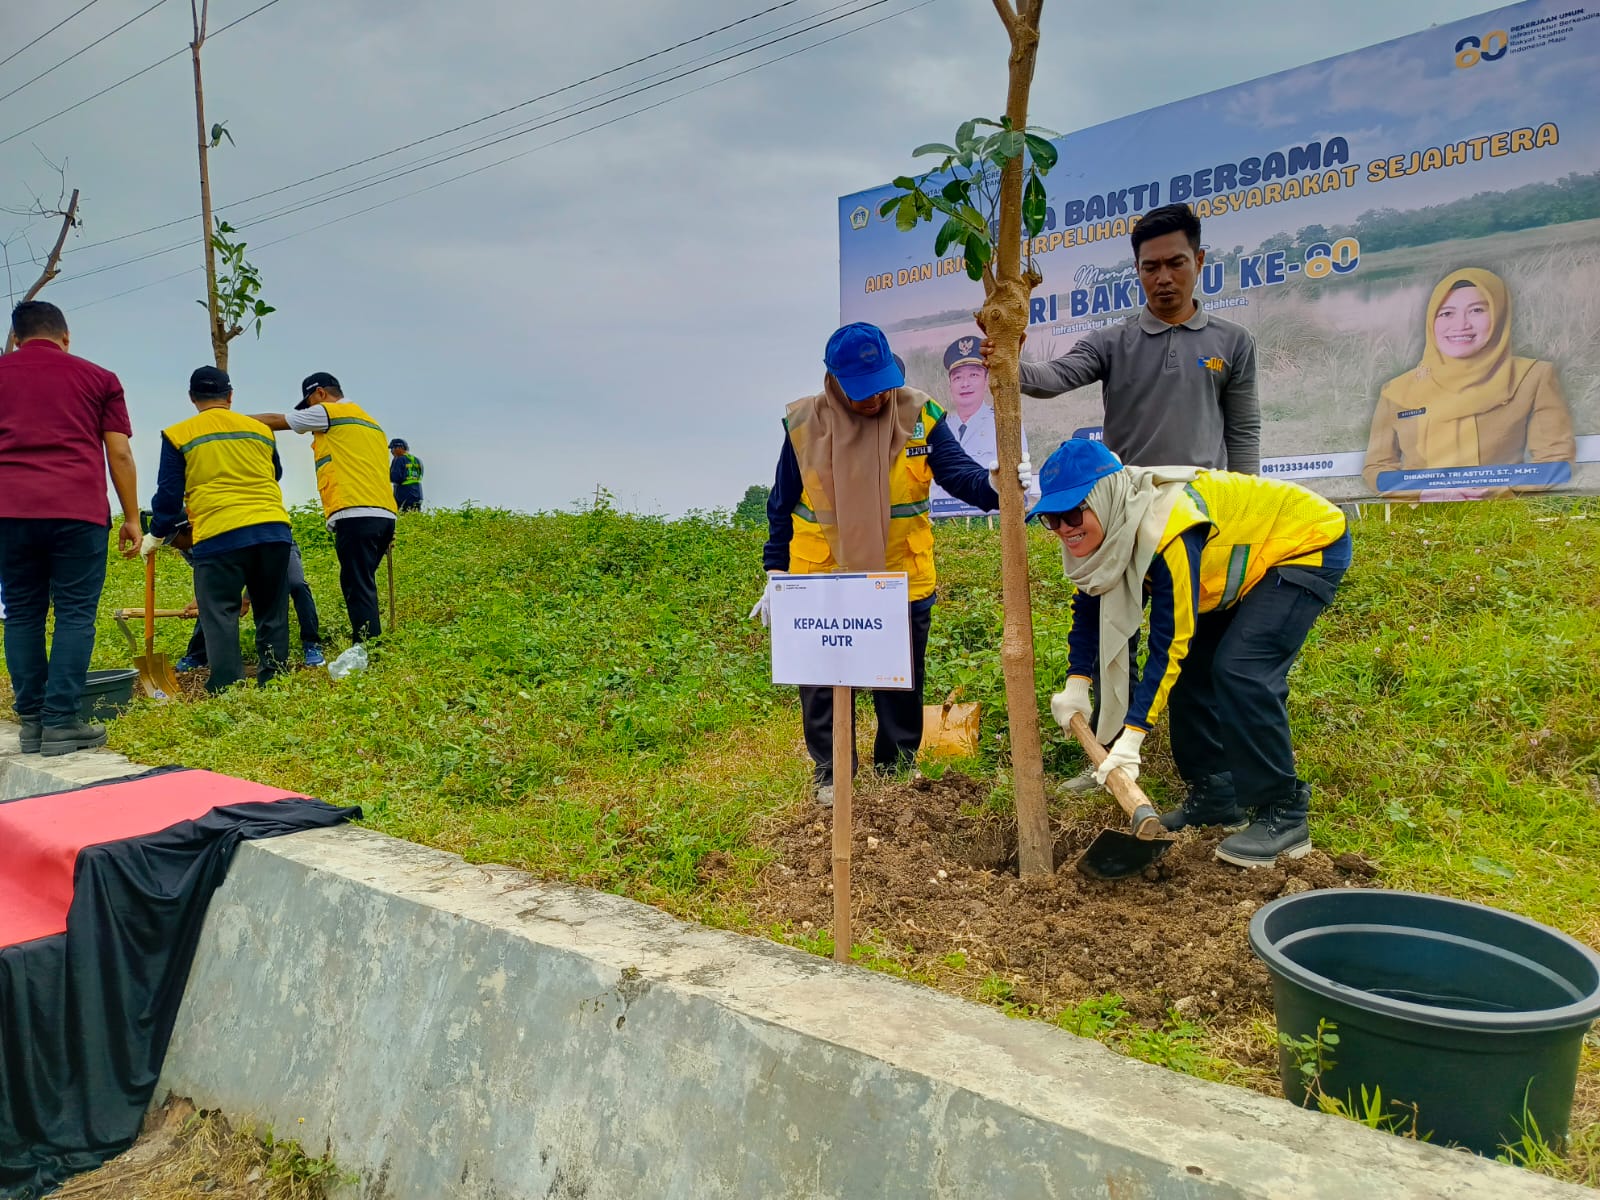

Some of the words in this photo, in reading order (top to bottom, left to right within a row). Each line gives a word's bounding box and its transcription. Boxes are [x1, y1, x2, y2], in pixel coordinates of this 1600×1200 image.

[1510, 15, 1557, 32] PEKERJAAN
[1510, 23, 1557, 39] Infrastruktur
[1538, 26, 1574, 40] Sejahtera
[1455, 29, 1508, 69] 80
[1510, 41, 1546, 54] Indonesia
[1065, 181, 1160, 227] BAKTI
[1170, 136, 1349, 202] BERSAMA
[865, 272, 893, 293] AIR
[897, 262, 932, 286] DAN
[1367, 122, 1559, 182] SEJAHTERA
[1239, 237, 1360, 290] KE-80
[1052, 318, 1105, 336] Infrastruktur
[1203, 296, 1248, 311] ejahtera,
[1262, 460, 1333, 473] 081233344500
[794, 618, 839, 630] KEPALA
[843, 618, 883, 630] DINAS
[822, 635, 853, 647] PUTR
